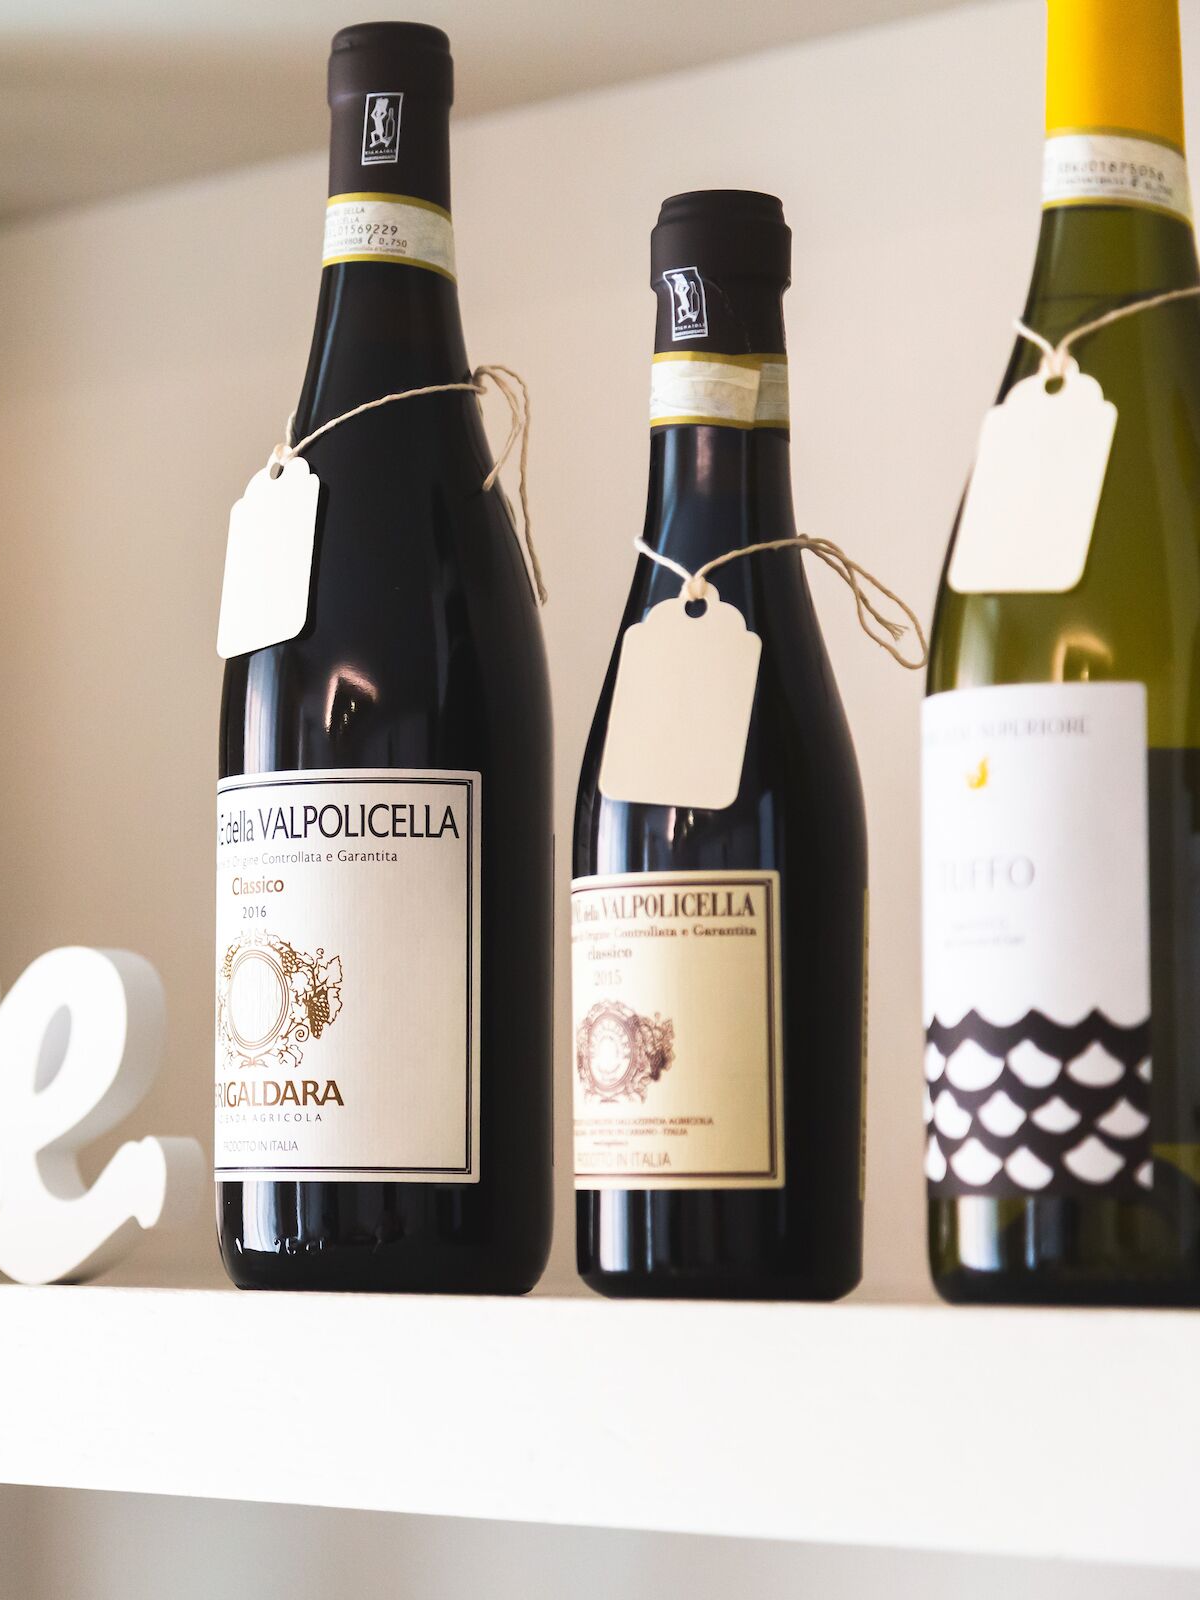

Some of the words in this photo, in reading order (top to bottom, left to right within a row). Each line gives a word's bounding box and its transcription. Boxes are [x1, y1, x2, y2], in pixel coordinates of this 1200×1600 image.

[378, 237, 408, 248] 0.750
[225, 810, 255, 844] della
[258, 803, 460, 839] VALPOLICELLA
[261, 850, 322, 865] Controllata
[325, 852, 334, 862] e
[337, 850, 398, 863] Garantita
[232, 876, 285, 895] Classico
[242, 905, 267, 919] 2016
[602, 891, 756, 920] VALPOLICELLA
[693, 923, 757, 937] Garantita
[253, 1112, 323, 1123] AGRICOLA
[269, 1140, 299, 1152] ITALIA
